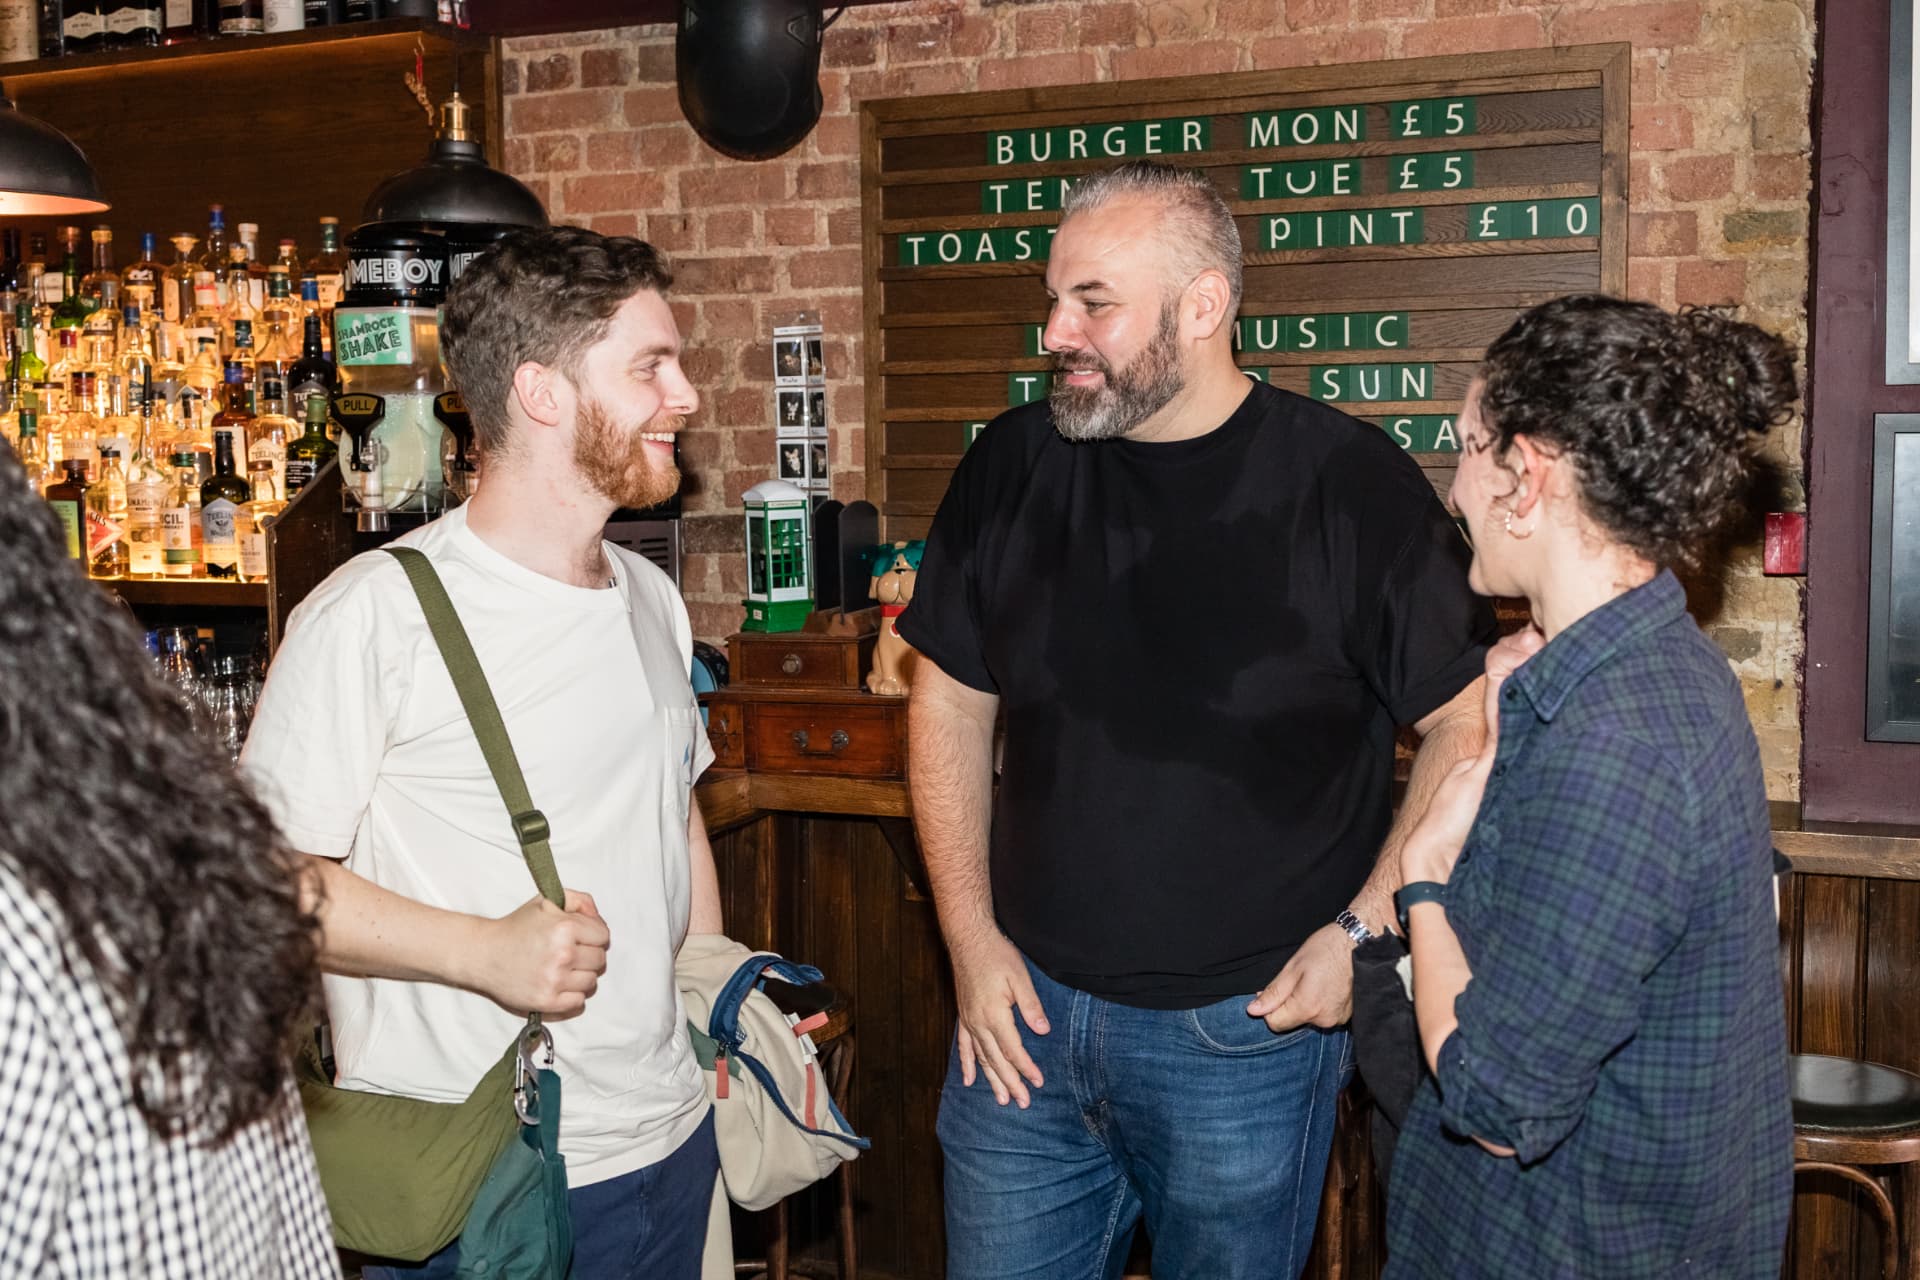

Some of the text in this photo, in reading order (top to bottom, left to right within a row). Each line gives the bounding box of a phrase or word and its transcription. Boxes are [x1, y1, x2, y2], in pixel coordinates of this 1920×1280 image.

[996, 120, 1203, 165] BURGER
[1250, 109, 1358, 148] MON
[1250, 163, 1351, 198] TUE
[345, 257, 444, 290] MEBOY
[337, 316, 397, 341] SHAMROCK
[339, 329, 402, 361] SHAKE
[1322, 367, 1426, 400] SUN
[343, 400, 371, 411] PULL
